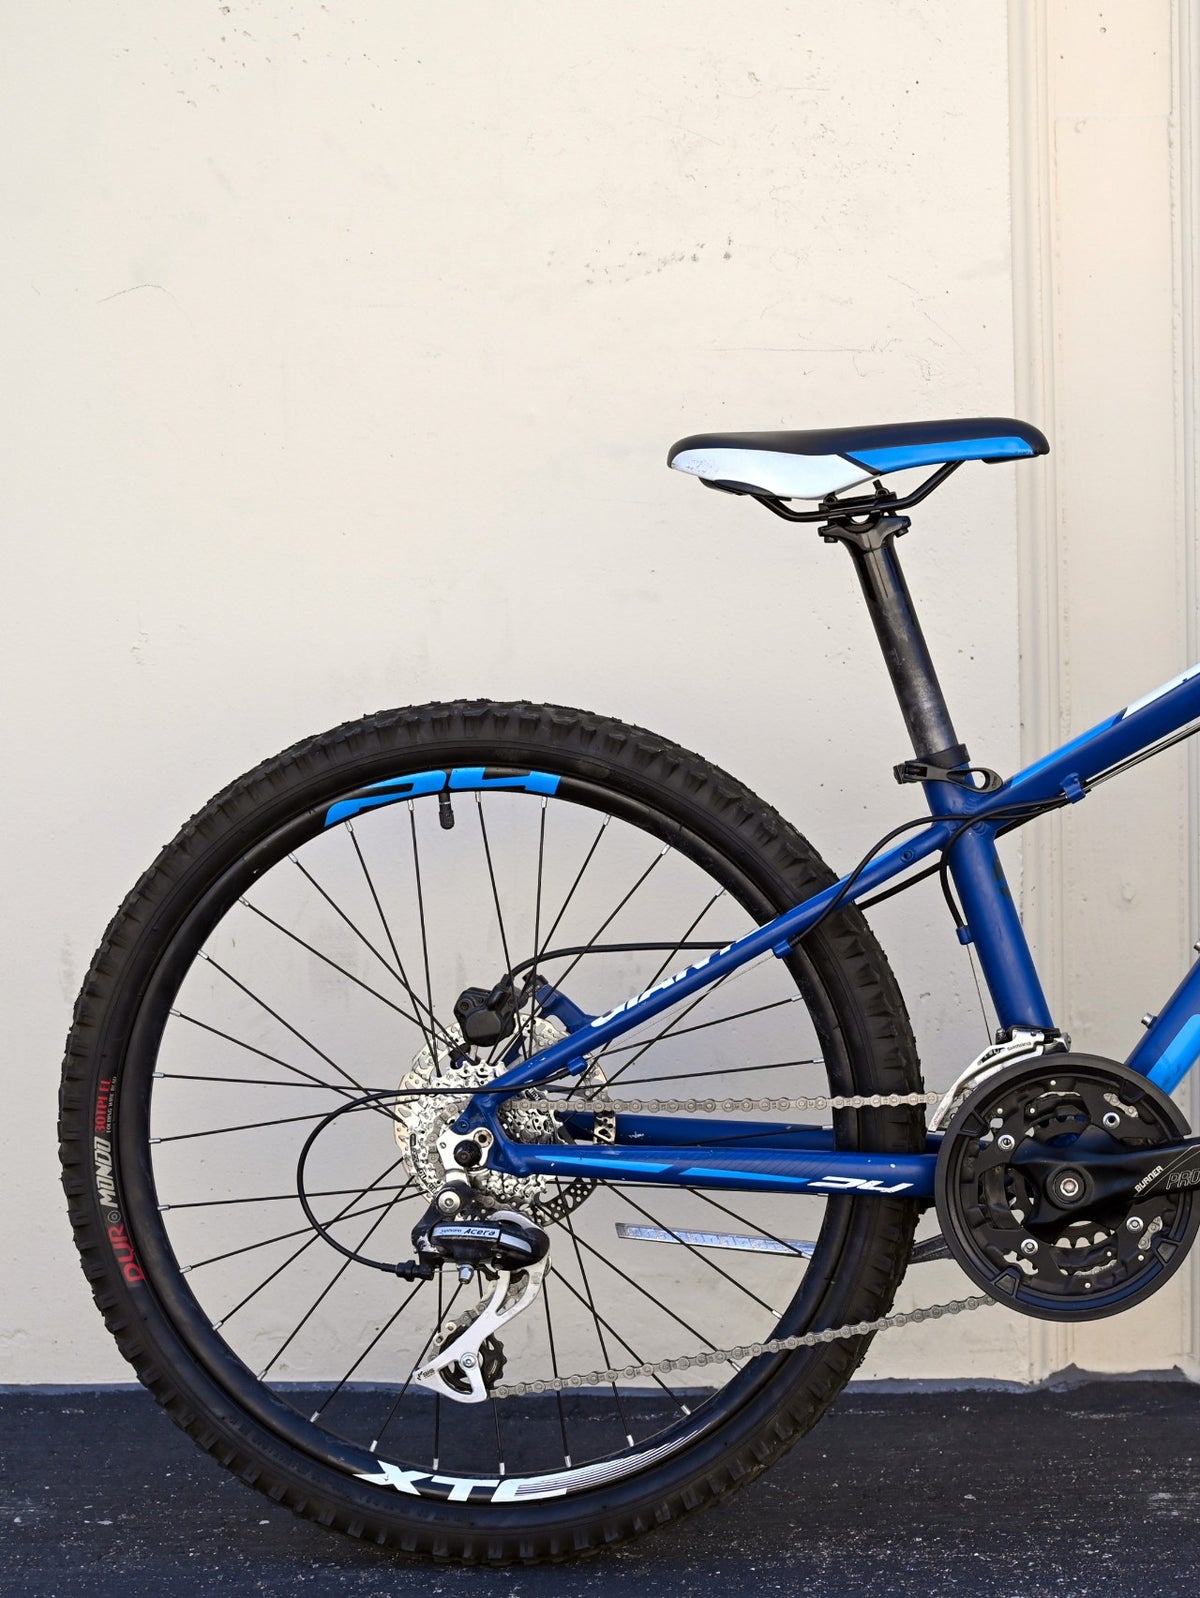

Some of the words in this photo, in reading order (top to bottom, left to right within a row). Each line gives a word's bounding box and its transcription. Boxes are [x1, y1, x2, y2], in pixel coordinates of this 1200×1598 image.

[93, 1135, 119, 1209] MONDO
[1134, 1165, 1164, 1193] BURNER
[463, 1228, 496, 1237] Acera
[352, 1460, 568, 1503] XTC
